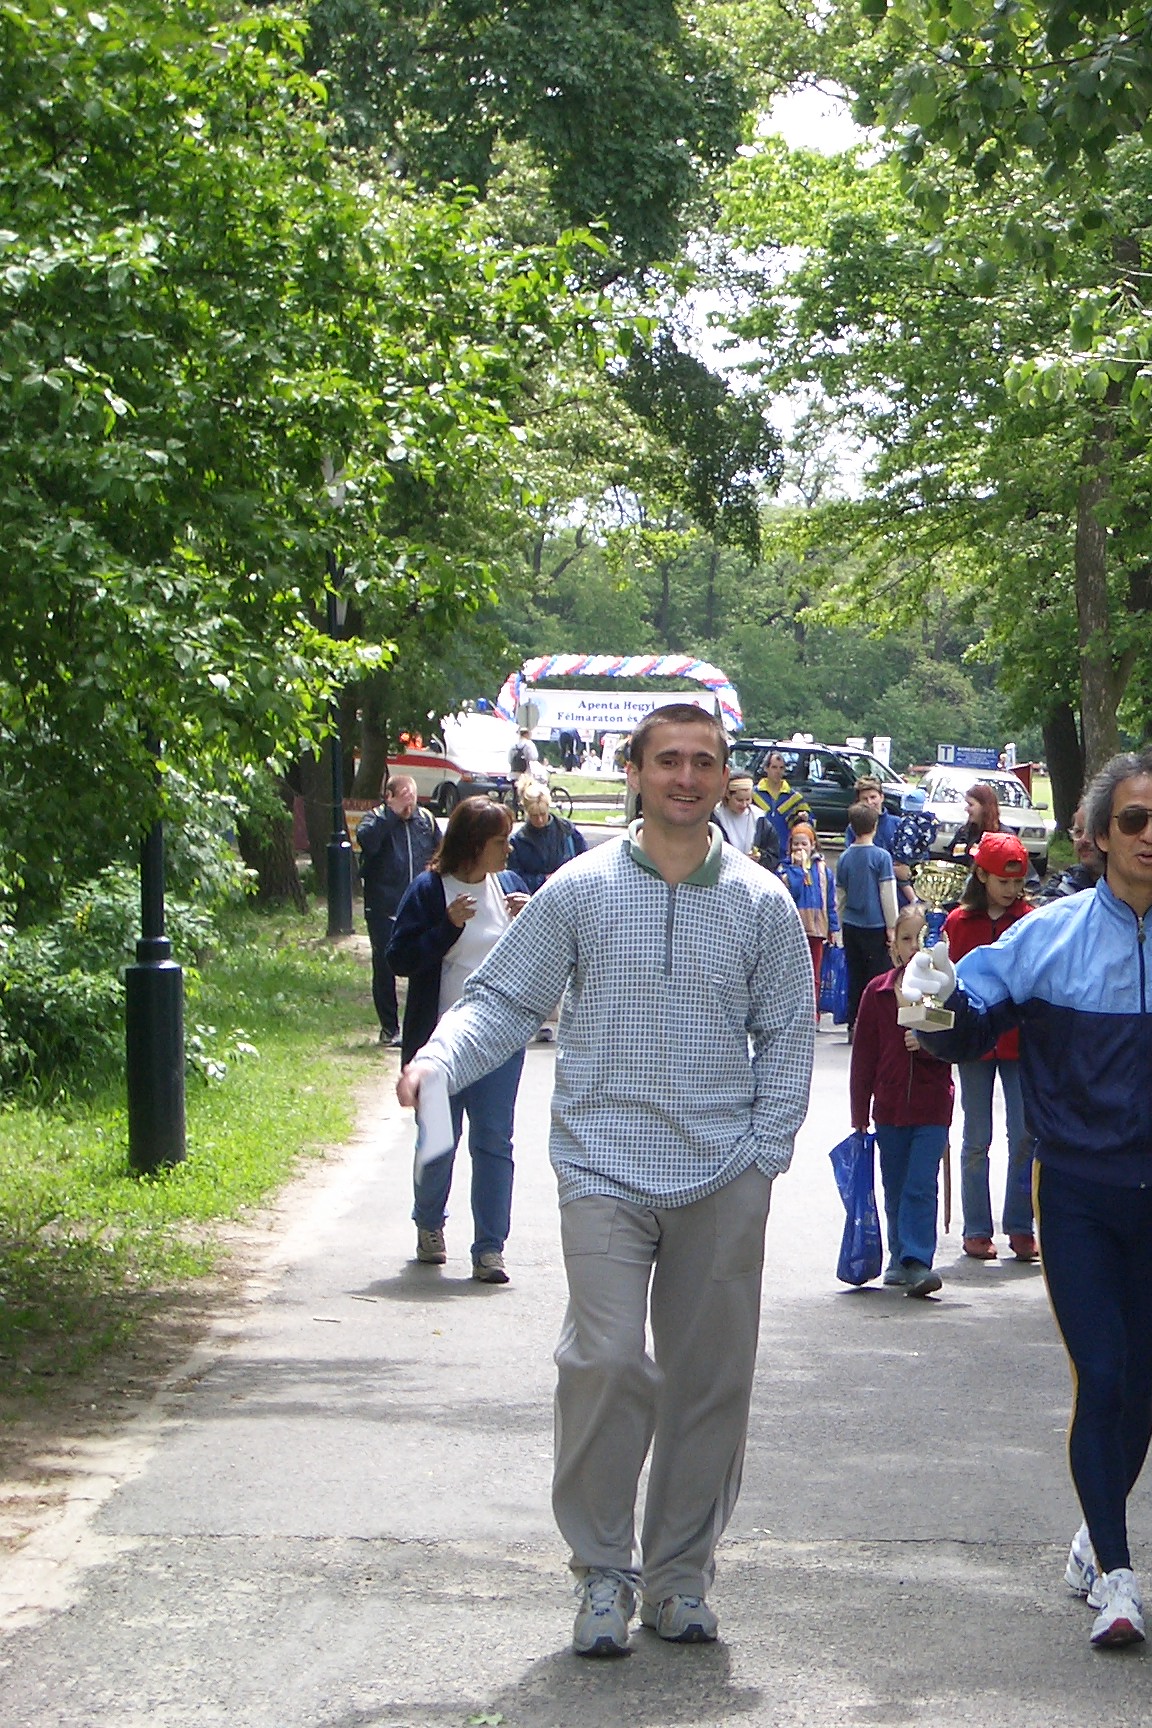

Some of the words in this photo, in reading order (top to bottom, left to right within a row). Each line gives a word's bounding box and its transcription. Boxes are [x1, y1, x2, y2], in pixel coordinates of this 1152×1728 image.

[578, 700, 620, 711] Apenta
[558, 712, 623, 722] Félmaraton
[941, 746, 952, 760] T
